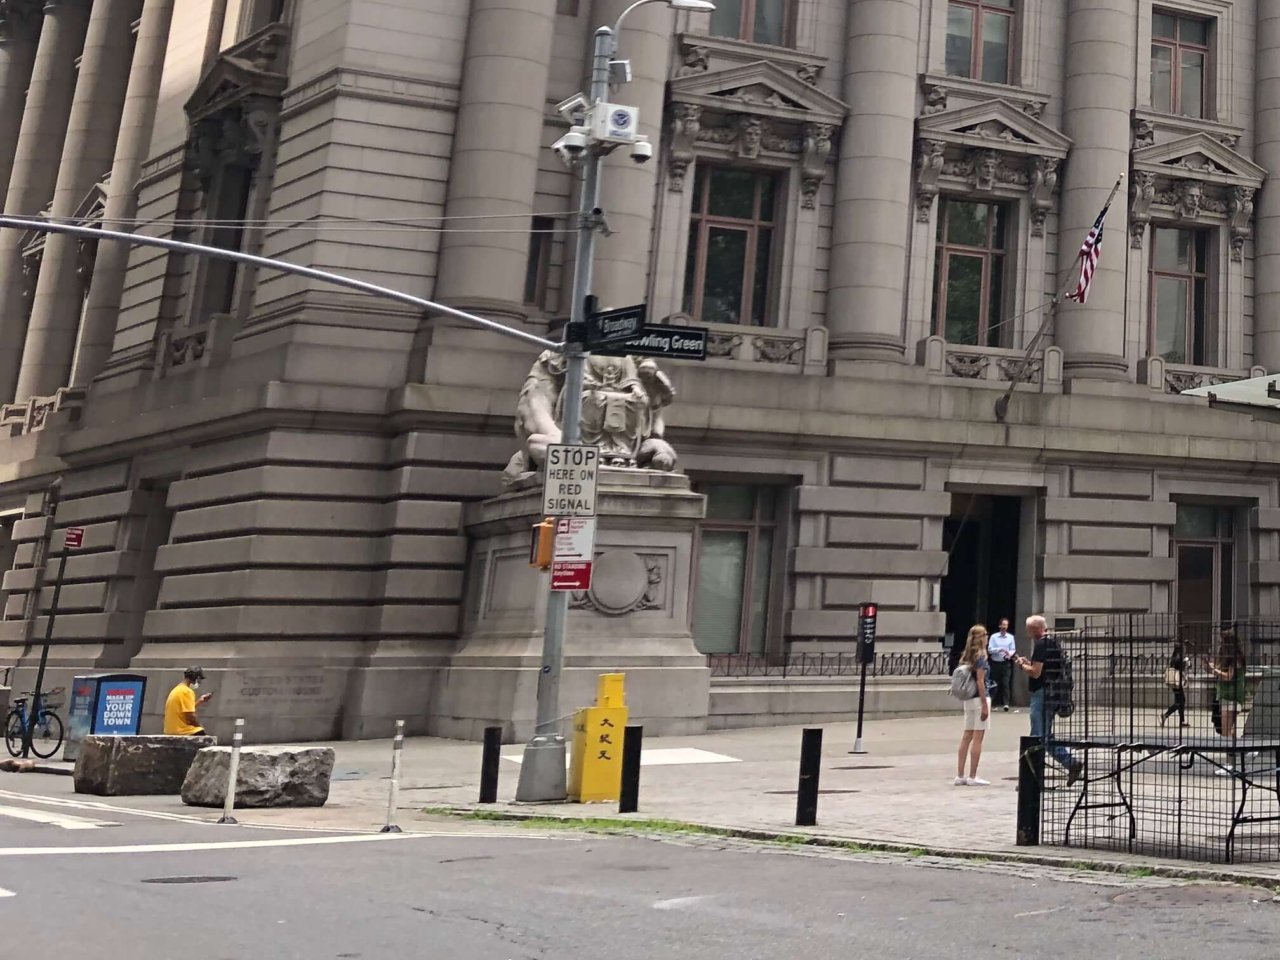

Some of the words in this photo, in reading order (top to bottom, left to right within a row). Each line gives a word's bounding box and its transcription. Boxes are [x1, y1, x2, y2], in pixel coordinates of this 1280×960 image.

[603, 317, 638, 333] Broadway
[625, 334, 670, 352] wling
[671, 335, 704, 350] Green
[550, 449, 595, 466] STOP
[549, 468, 575, 480] HERE
[580, 469, 594, 481] ON
[558, 483, 582, 495] RED
[547, 498, 591, 510] SIGNAL
[106, 703, 133, 711] YOUR
[103, 710, 132, 718] DOWN
[103, 717, 131, 726] TOWN
